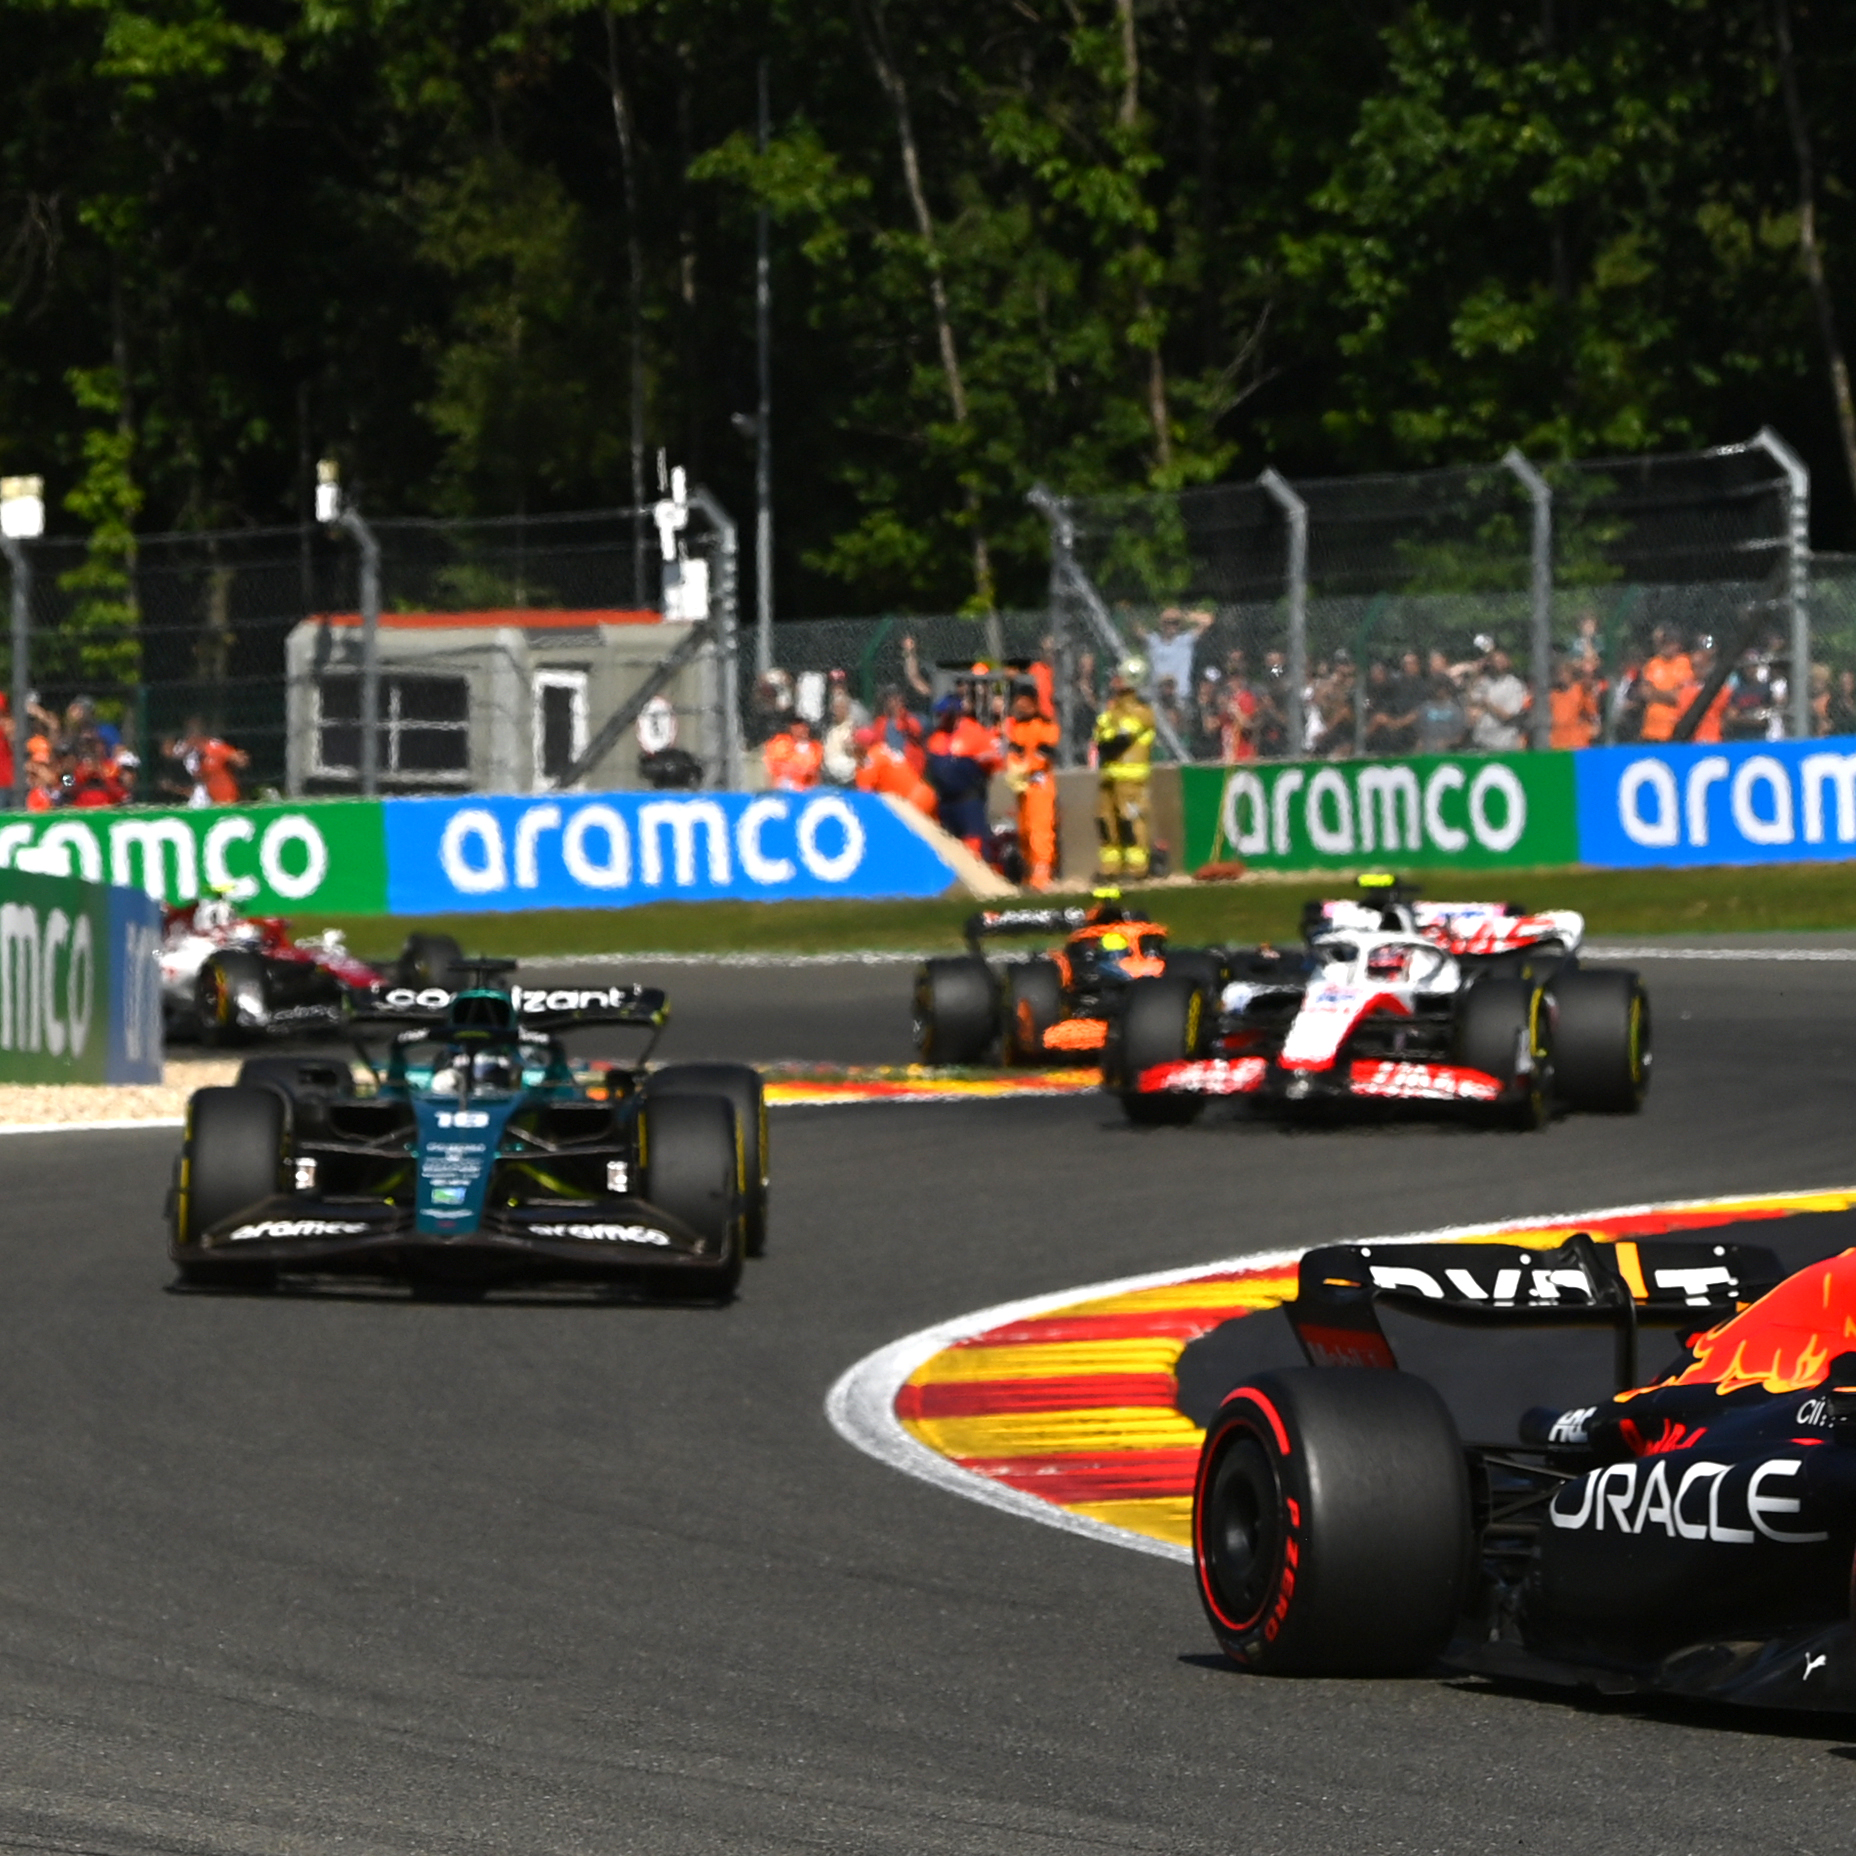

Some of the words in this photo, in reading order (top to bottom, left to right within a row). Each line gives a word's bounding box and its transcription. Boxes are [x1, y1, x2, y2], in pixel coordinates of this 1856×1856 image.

[441, 795, 866, 894] aramco
[1222, 764, 1526, 855] aramco
[385, 984, 626, 1013] coizant
